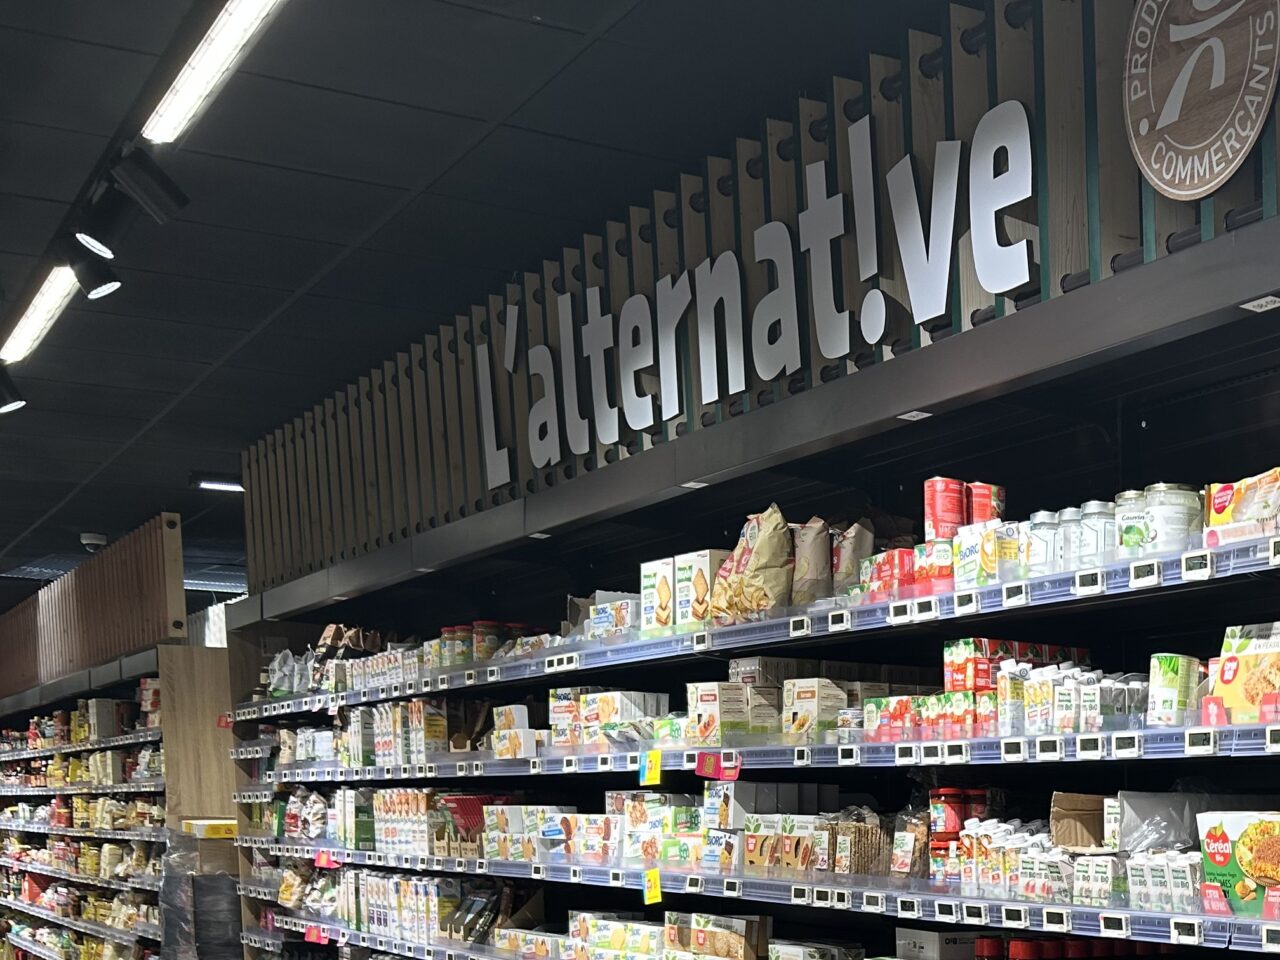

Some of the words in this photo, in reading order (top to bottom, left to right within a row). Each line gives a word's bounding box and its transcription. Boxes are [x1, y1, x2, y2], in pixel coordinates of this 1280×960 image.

[1131, 0, 1162, 101] PROD
[1151, 10, 1275, 185] COMMERÇANTS
[1204, 838, 1233, 854] Céréal
